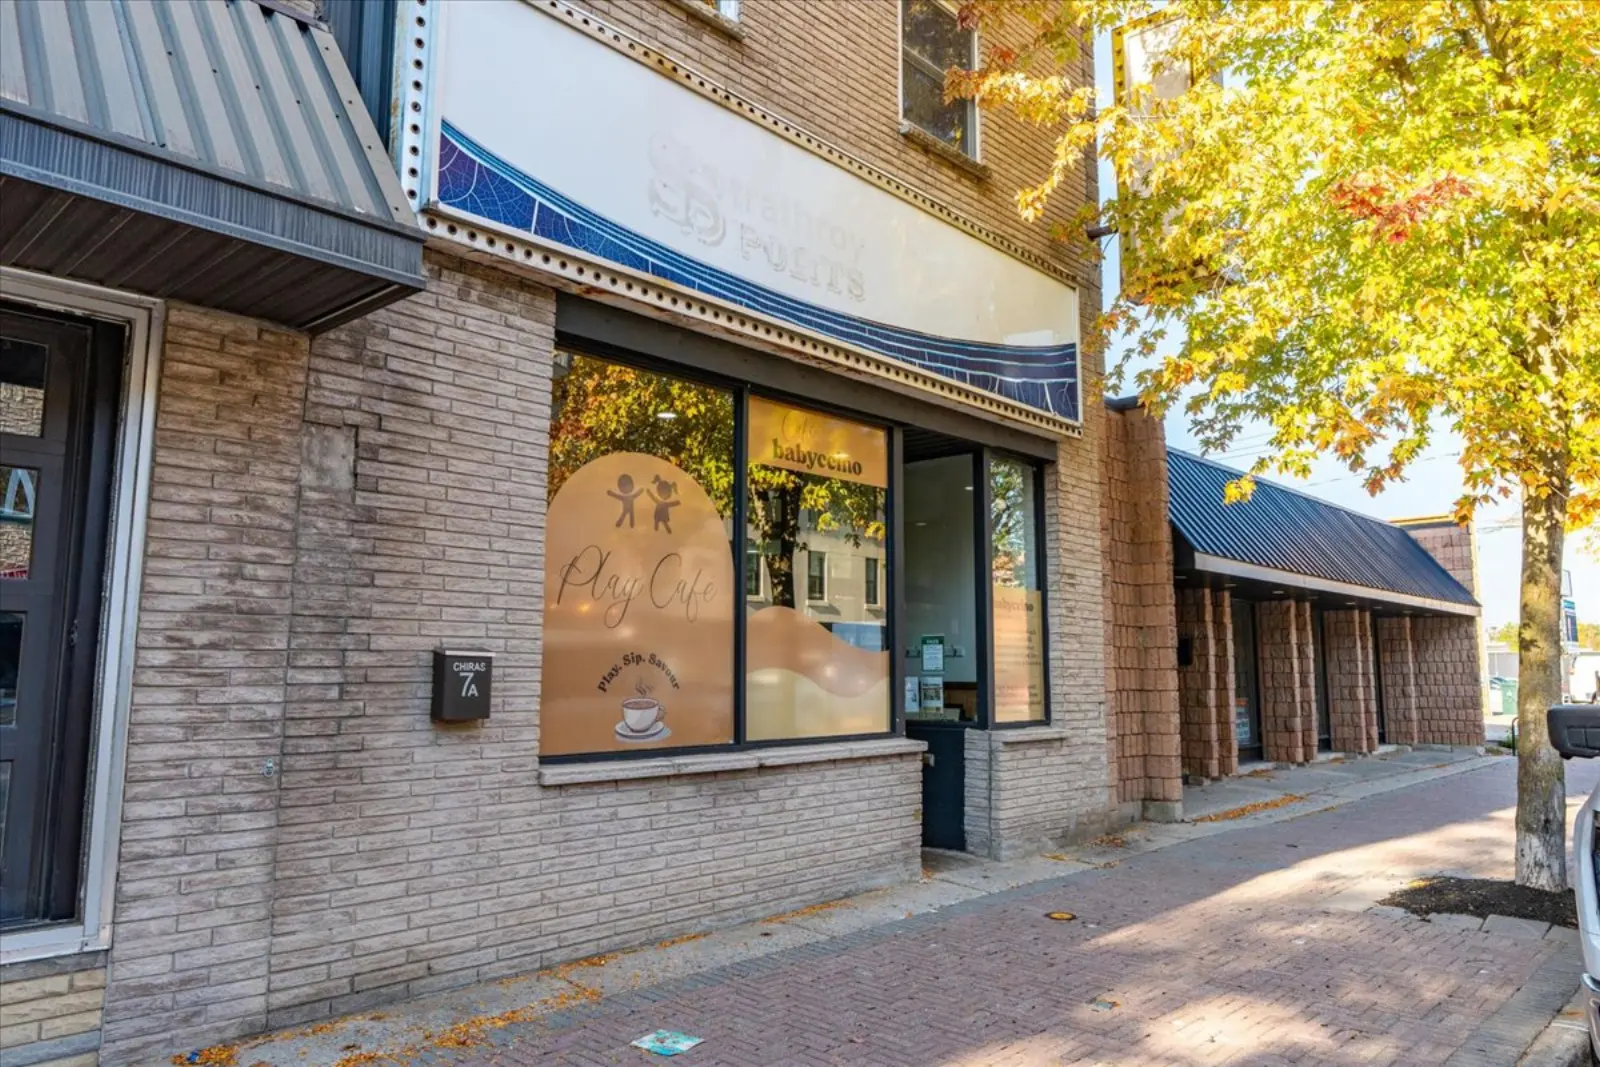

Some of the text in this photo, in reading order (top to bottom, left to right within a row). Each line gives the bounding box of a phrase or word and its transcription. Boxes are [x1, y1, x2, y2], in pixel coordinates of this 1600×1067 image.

[557, 545, 645, 628] Play
[452, 661, 487, 672] CHIRAS
[597, 651, 681, 693] Play. Sip. Savour
[459, 671, 479, 697] 7A
